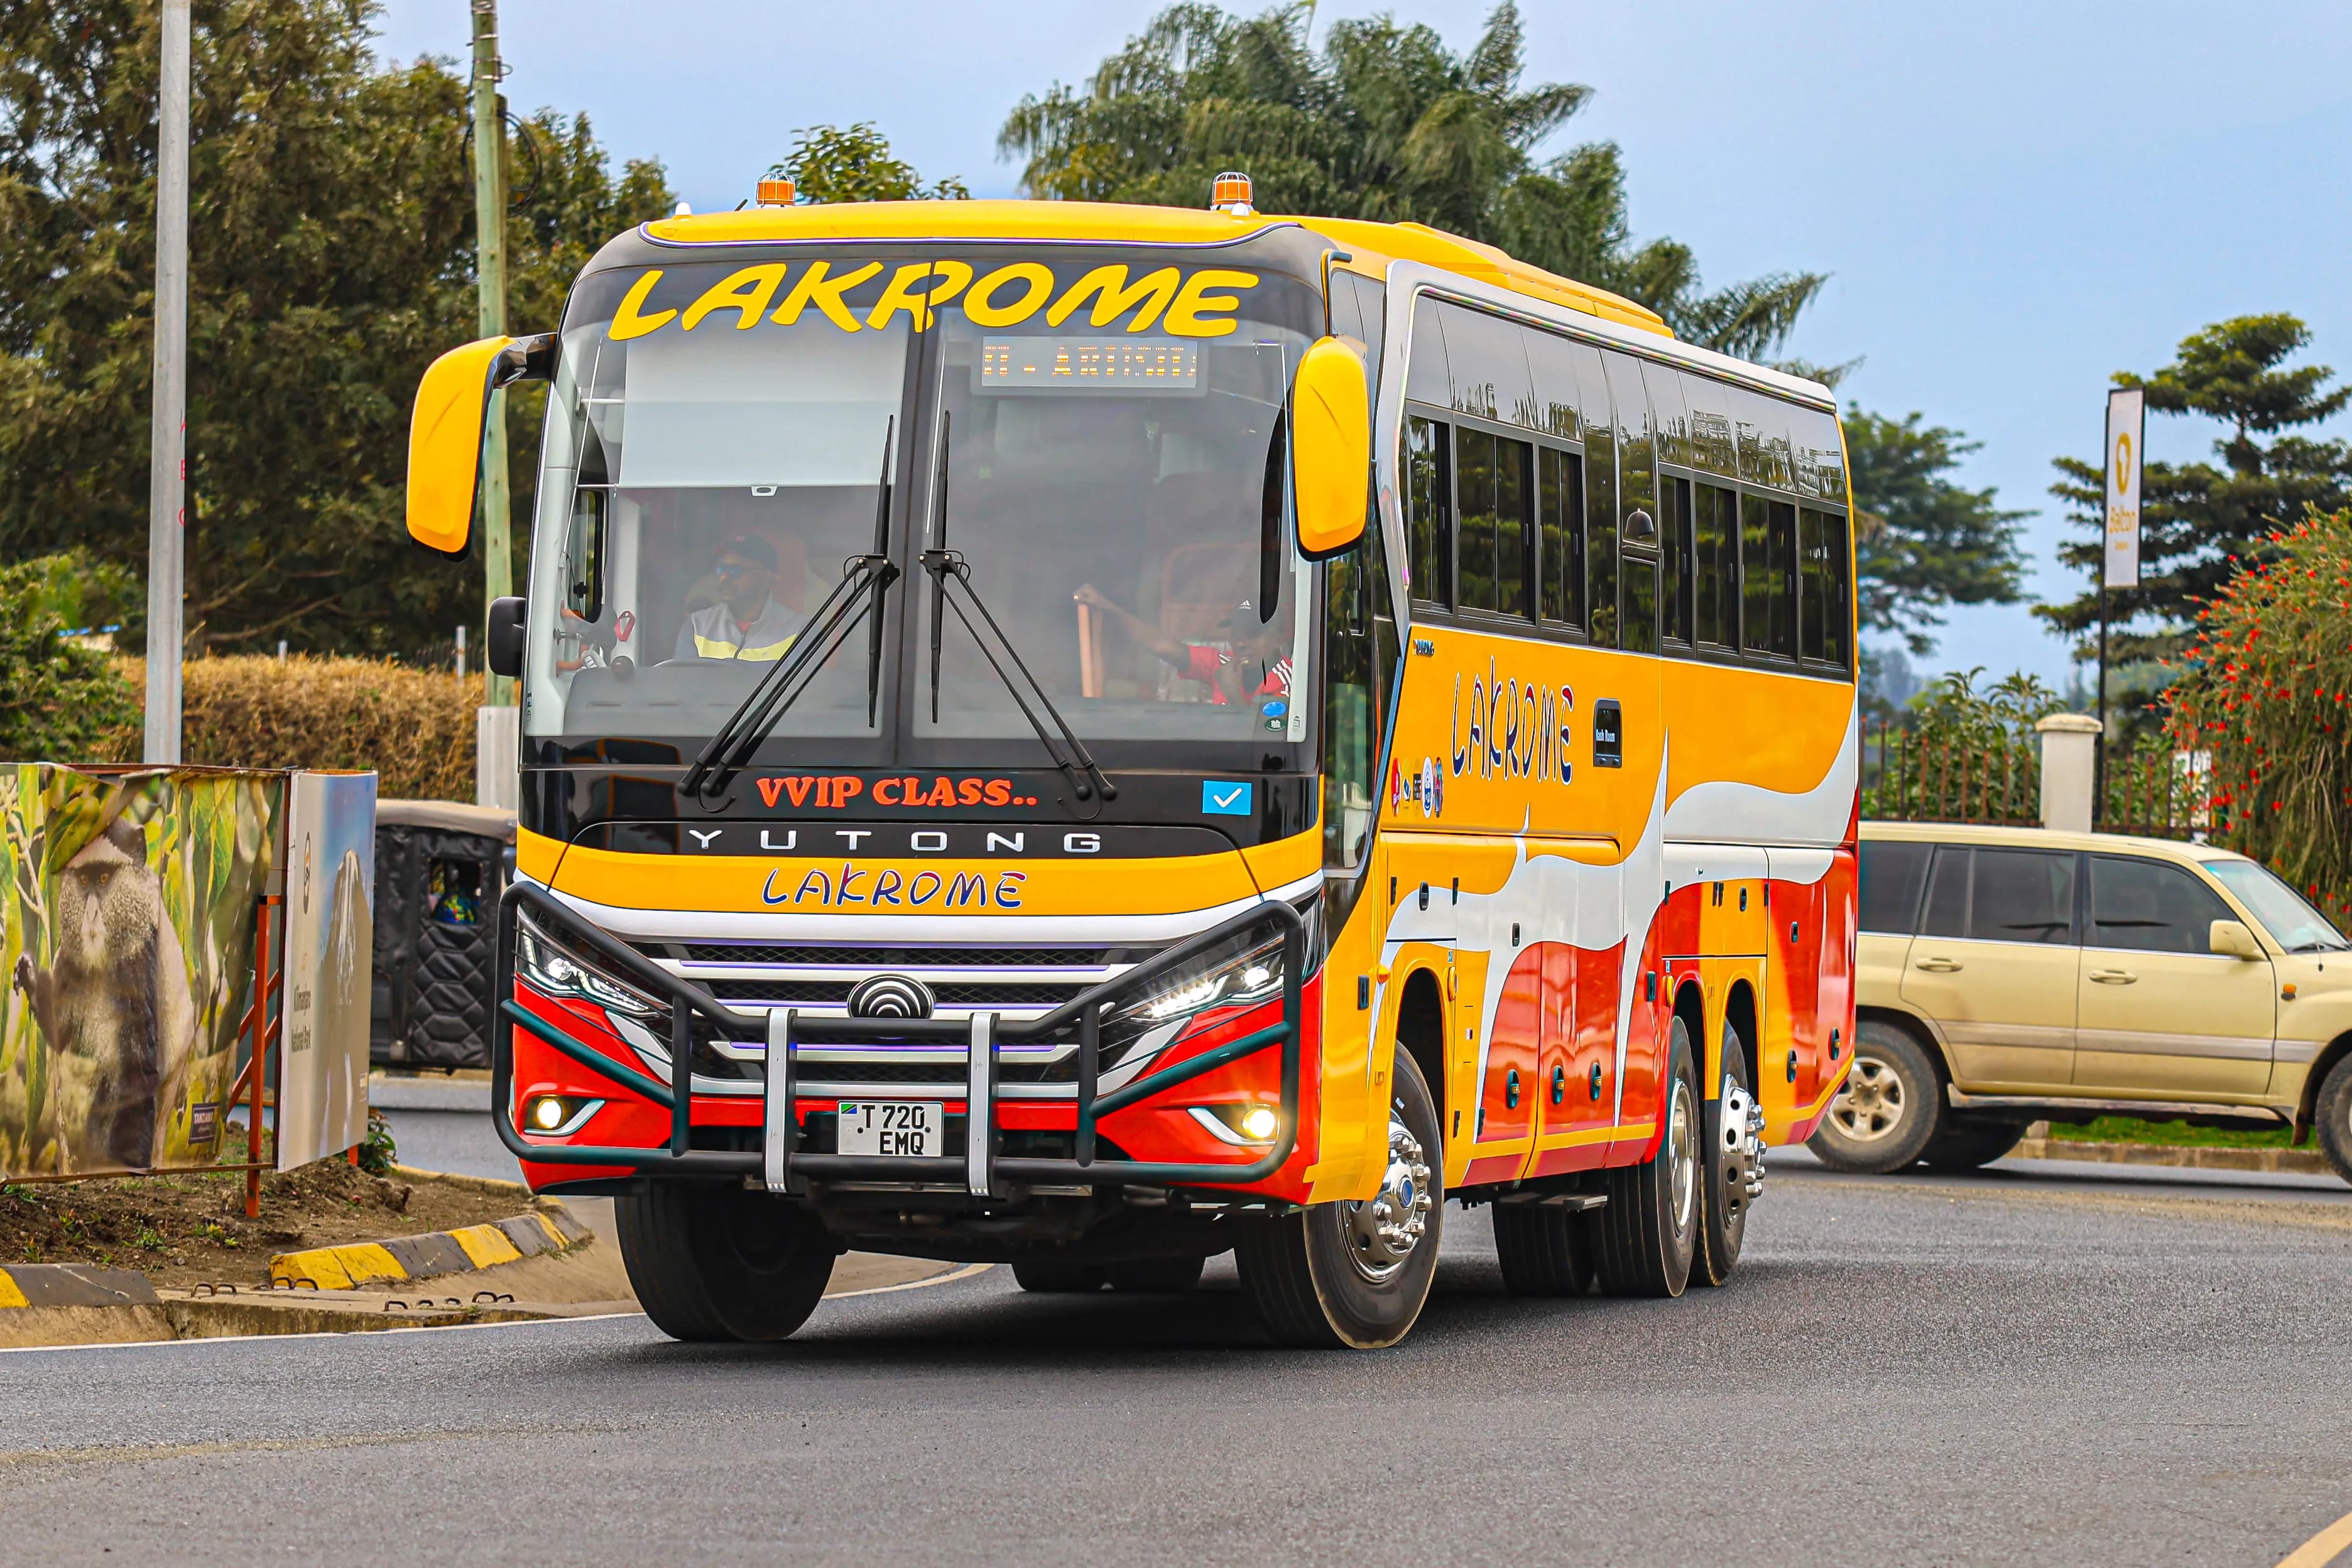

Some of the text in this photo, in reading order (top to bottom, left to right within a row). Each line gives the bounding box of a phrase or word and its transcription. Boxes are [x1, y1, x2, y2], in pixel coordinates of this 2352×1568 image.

[607, 259, 1260, 342] LAKROME
[1451, 655, 1574, 785] LAKROME
[756, 775, 1038, 808] VVIP CLASS..
[689, 829, 1101, 853] YUTONG
[760, 861, 1029, 910] LAKROME
[861, 1104, 925, 1130] T 720
[879, 1131, 924, 1155] EMQ
